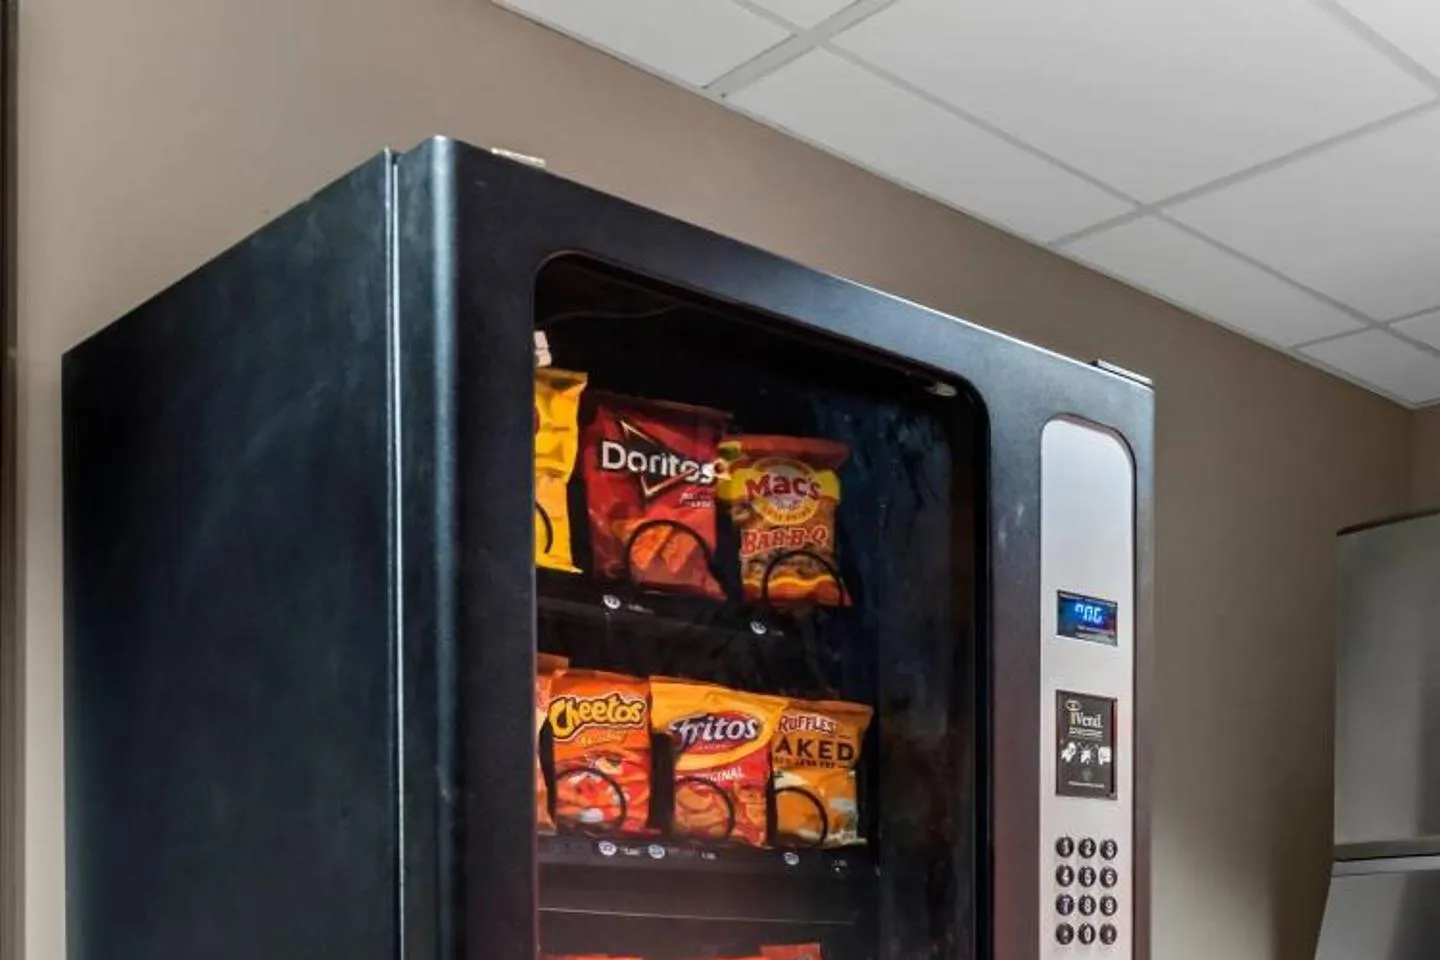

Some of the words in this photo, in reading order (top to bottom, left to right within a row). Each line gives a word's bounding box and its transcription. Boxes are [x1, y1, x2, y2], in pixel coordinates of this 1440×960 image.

[602, 440, 715, 484] Doritos
[548, 695, 646, 738] Cheetos
[668, 714, 759, 749] Fritos
[774, 735, 855, 761] AKED
